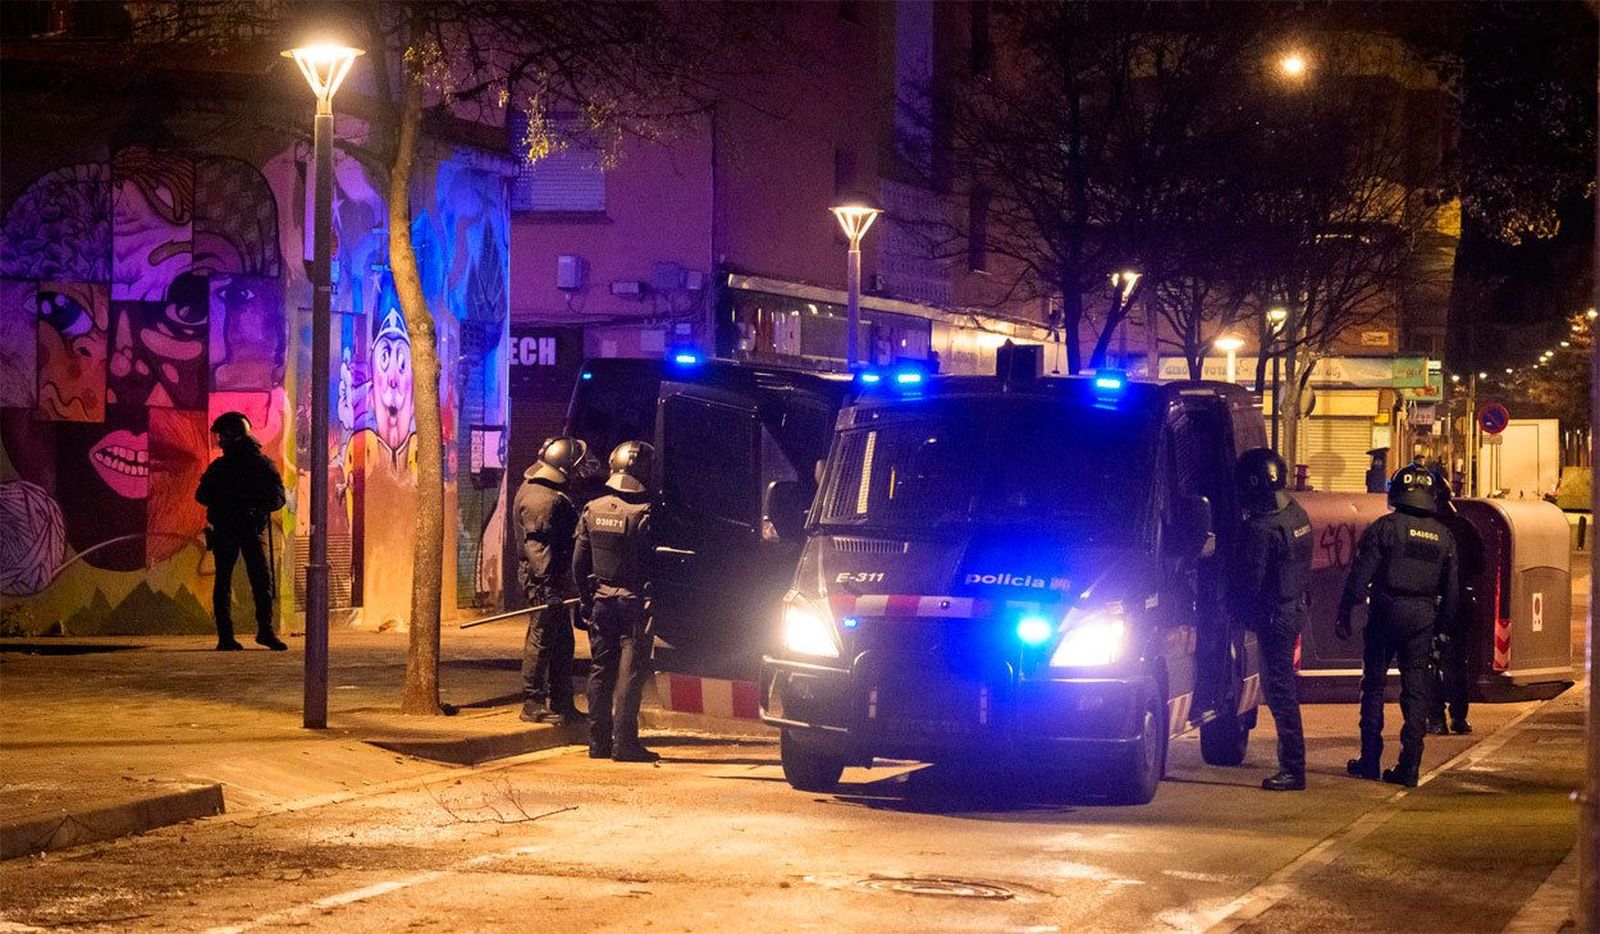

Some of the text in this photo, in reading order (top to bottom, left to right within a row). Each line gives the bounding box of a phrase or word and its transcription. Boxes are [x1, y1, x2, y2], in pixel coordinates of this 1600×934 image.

[509, 337, 555, 365] ECH
[835, 572, 885, 583] E-311
[965, 573, 1045, 589] policia
